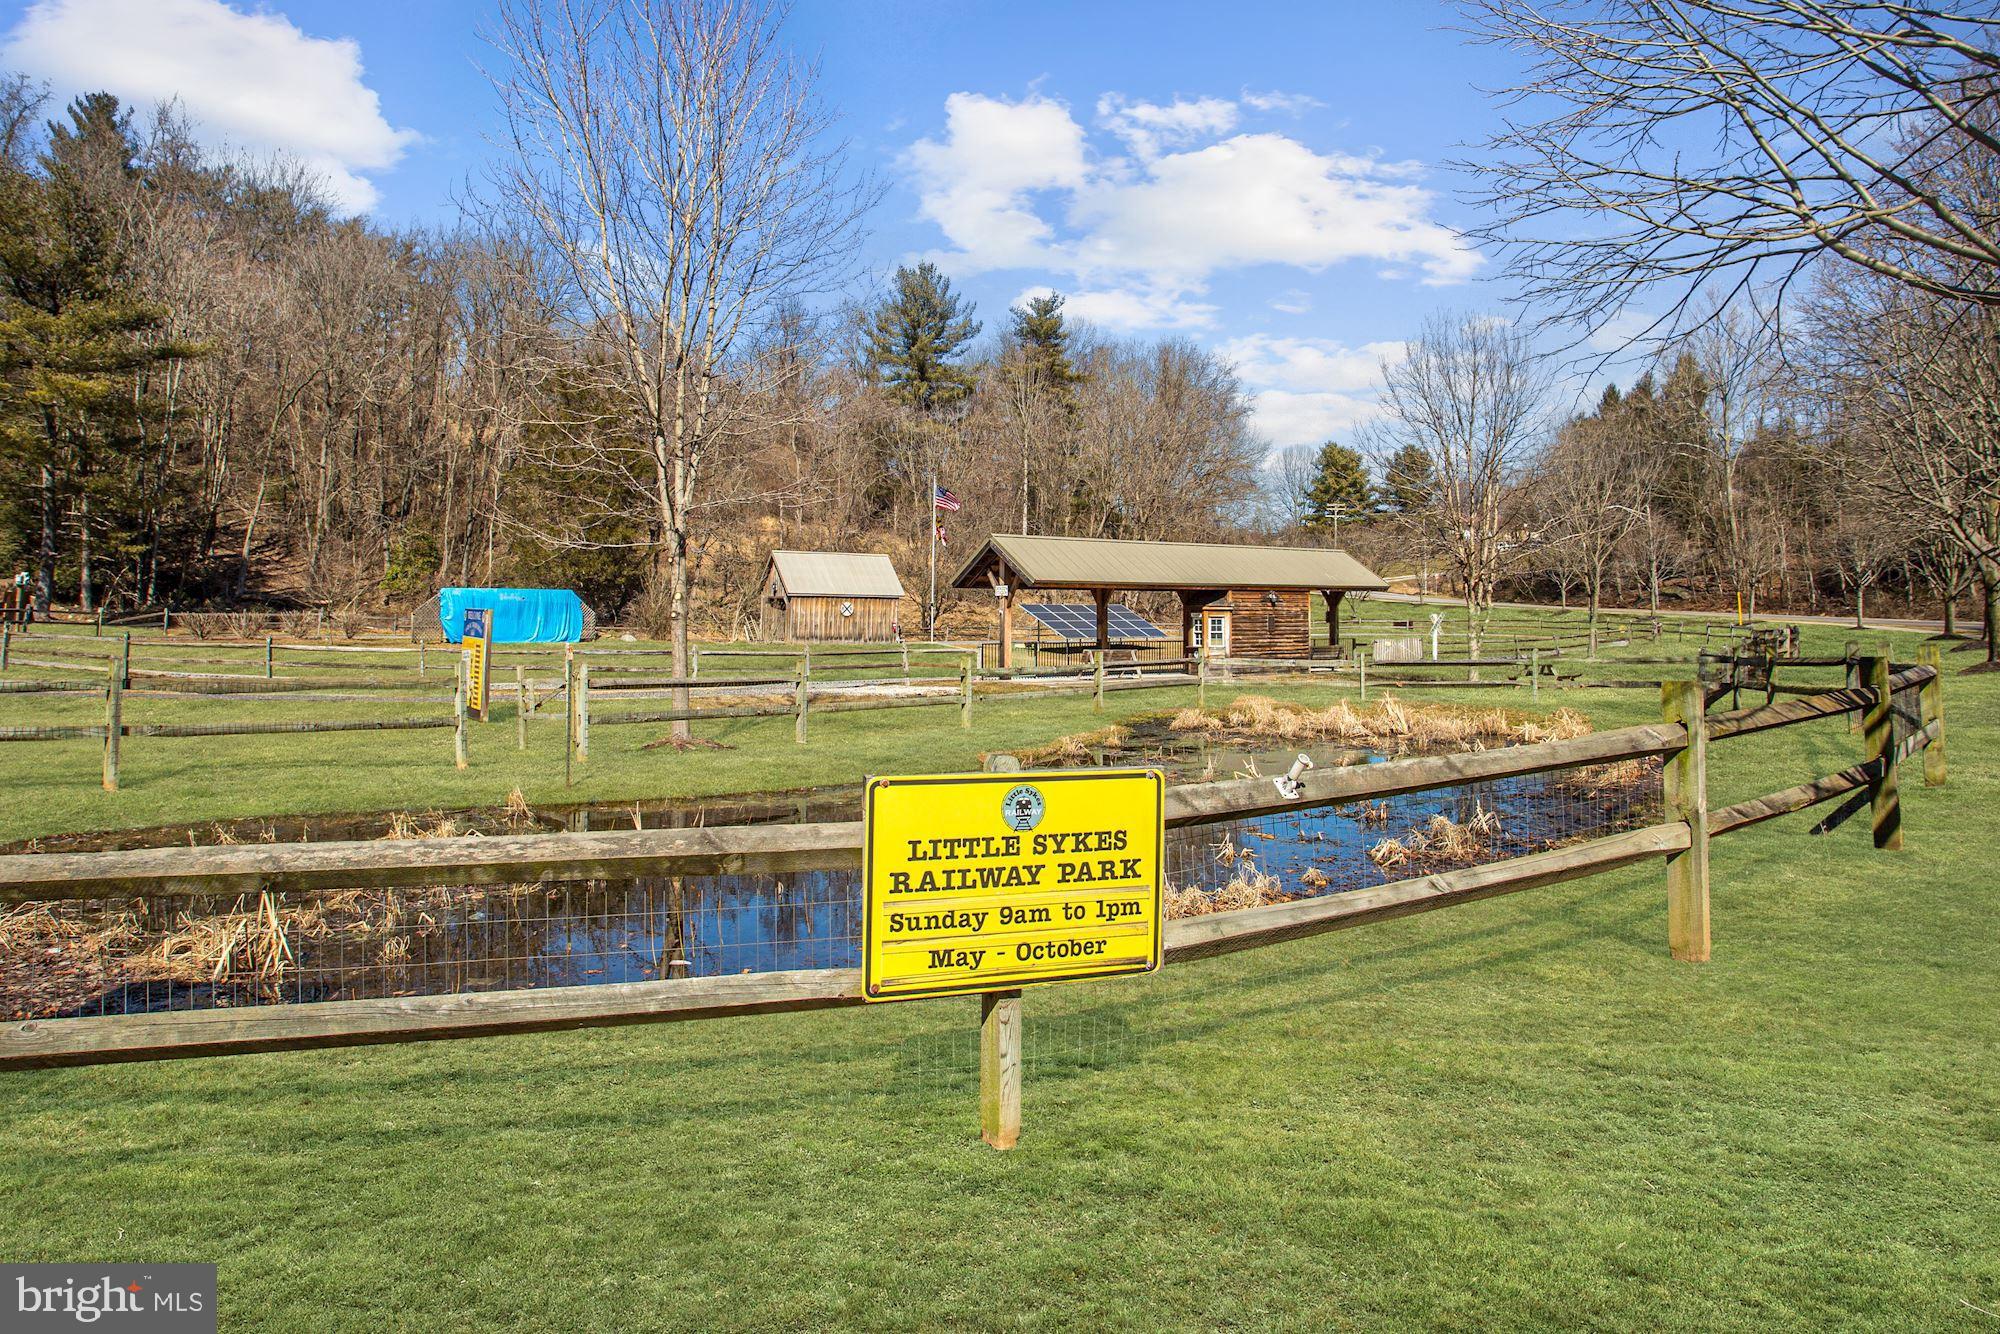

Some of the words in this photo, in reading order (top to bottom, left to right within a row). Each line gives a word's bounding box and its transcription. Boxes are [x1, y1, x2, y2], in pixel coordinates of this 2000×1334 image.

[1004, 808, 1042, 817] RAILWAY
[1005, 789, 1023, 807] Little
[1024, 787, 1042, 806] Sykes
[907, 836, 1021, 862] LITTLE
[1032, 830, 1128, 855] SYKES
[888, 864, 1046, 894] RAILWAY
[1057, 858, 1142, 884] PARK
[889, 909, 989, 933] Sunday
[999, 906, 1052, 926] 9am
[1062, 902, 1086, 920] to
[1095, 900, 1142, 922] 1pm
[927, 948, 987, 971] May
[1016, 938, 1107, 962] October
